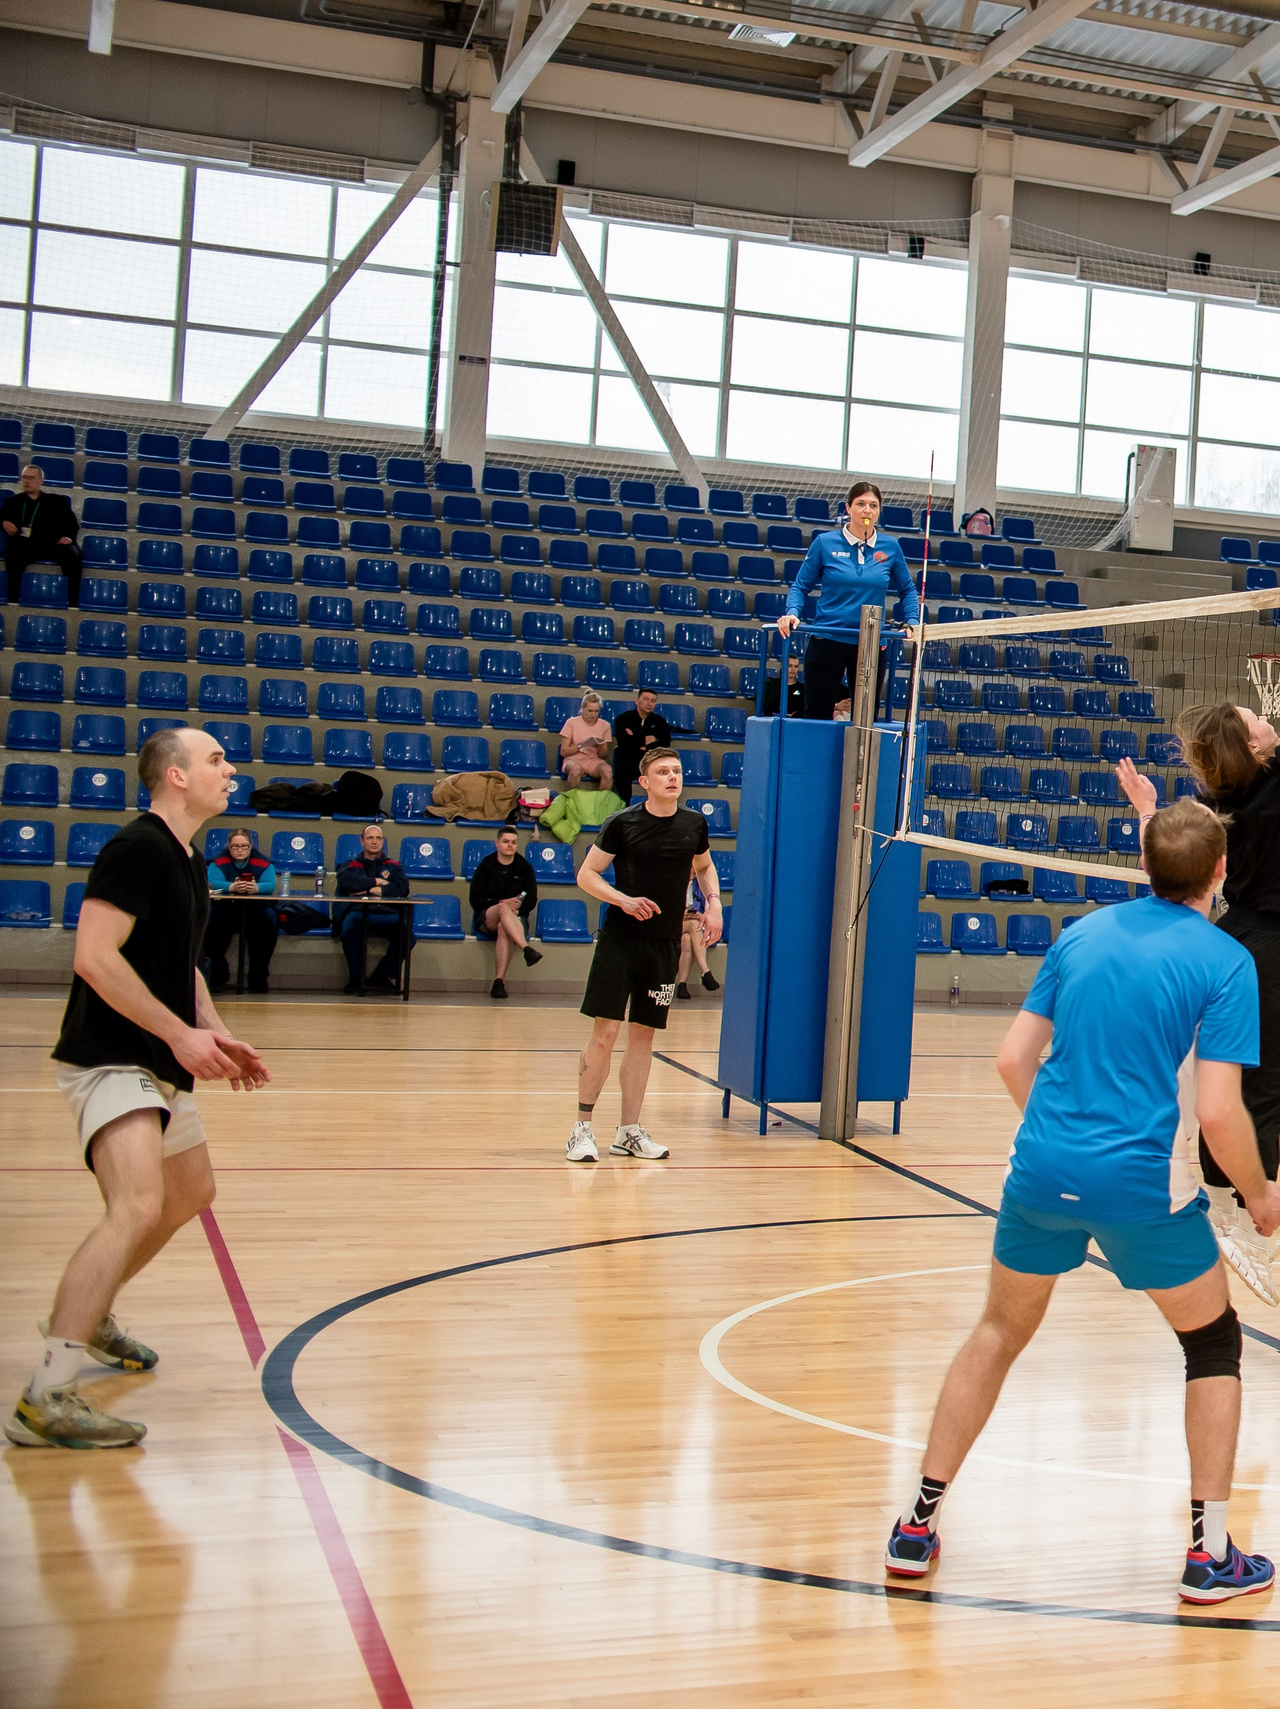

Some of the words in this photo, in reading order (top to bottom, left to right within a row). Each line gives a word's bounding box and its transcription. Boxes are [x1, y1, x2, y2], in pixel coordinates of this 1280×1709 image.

[93, 775, 106, 783] VIP
[20, 829, 34, 837] VIP
[291, 839, 305, 847] VIP
[420, 846, 433, 854] VIP
[543, 850, 555, 858] VIP
[660, 983, 675, 992] THE
[656, 998, 672, 1006] FAC
